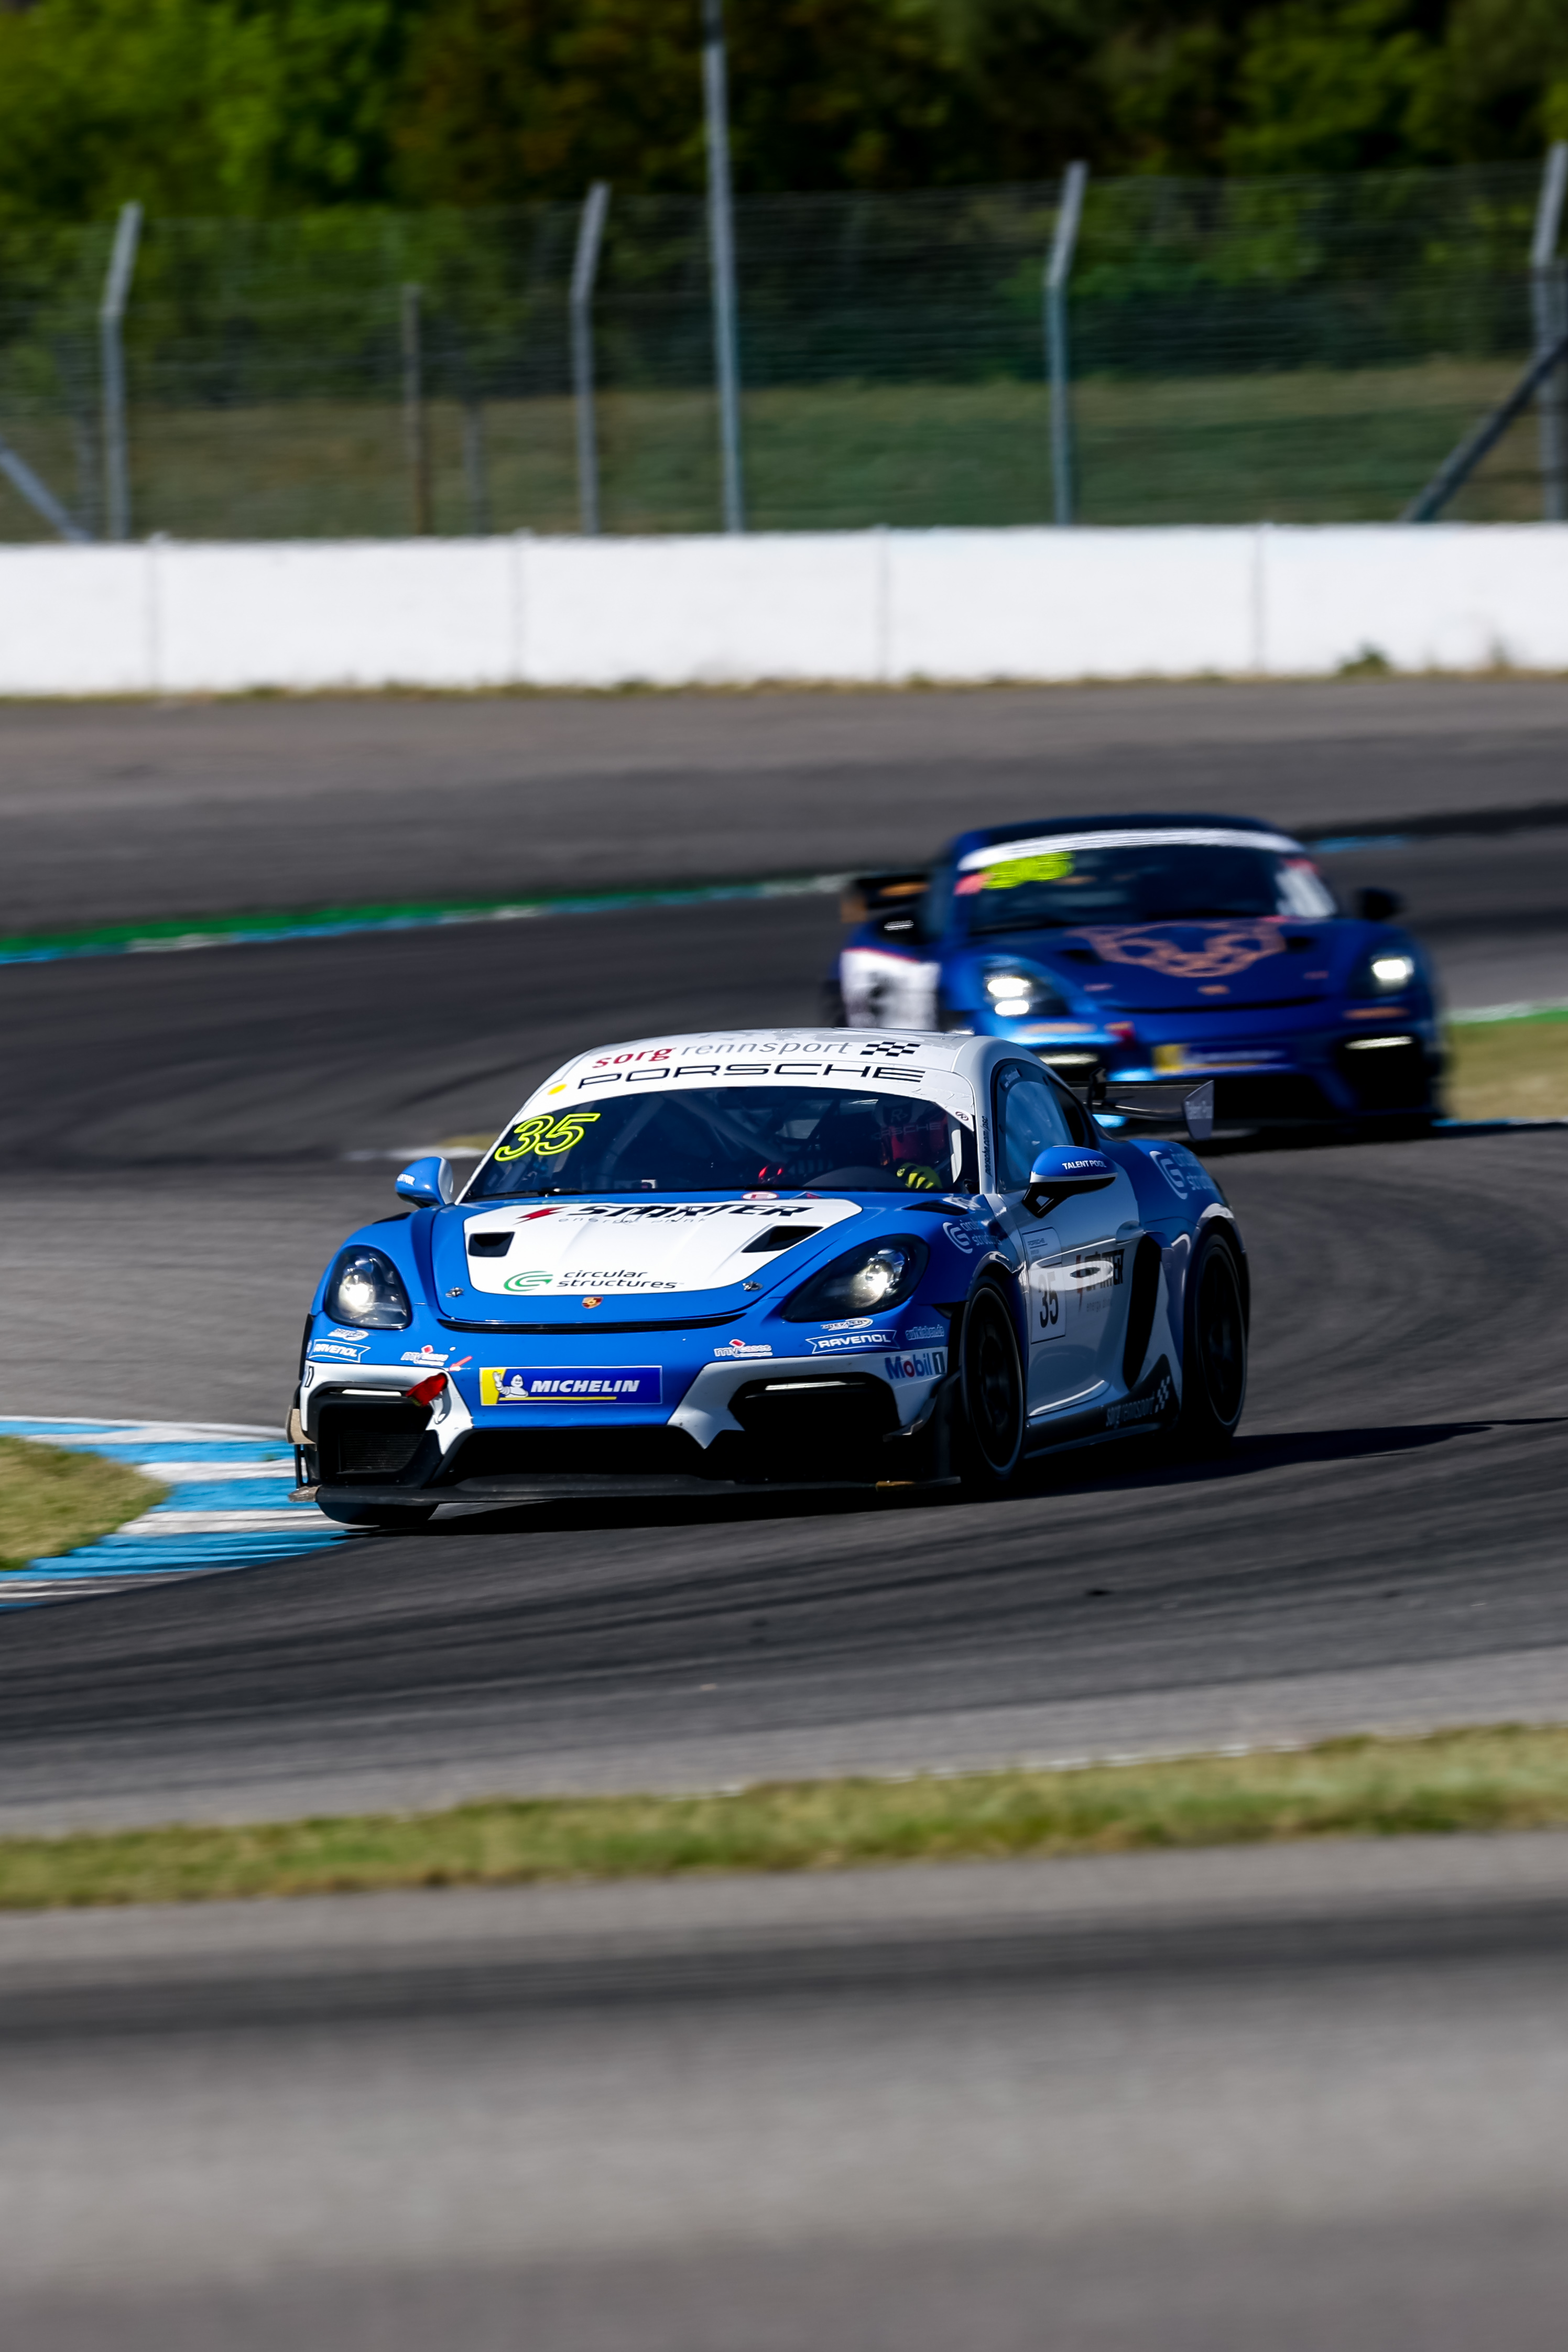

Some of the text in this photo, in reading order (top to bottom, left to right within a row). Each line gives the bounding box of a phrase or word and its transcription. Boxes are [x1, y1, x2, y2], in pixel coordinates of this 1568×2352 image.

[592, 1042, 853, 1069] sorg rennsport
[577, 1063, 926, 1090] PORSCHE
[494, 1113, 601, 1162] 35
[1061, 1160, 1089, 1170] TALENT
[564, 1269, 648, 1278] circular
[557, 1279, 678, 1289] structures
[1038, 1271, 1059, 1329] 35
[818, 1334, 891, 1348] RAVENOL
[314, 1343, 357, 1357] RAVENOL
[885, 1353, 933, 1379] Mobil
[530, 1380, 640, 1393] MICHELIN
